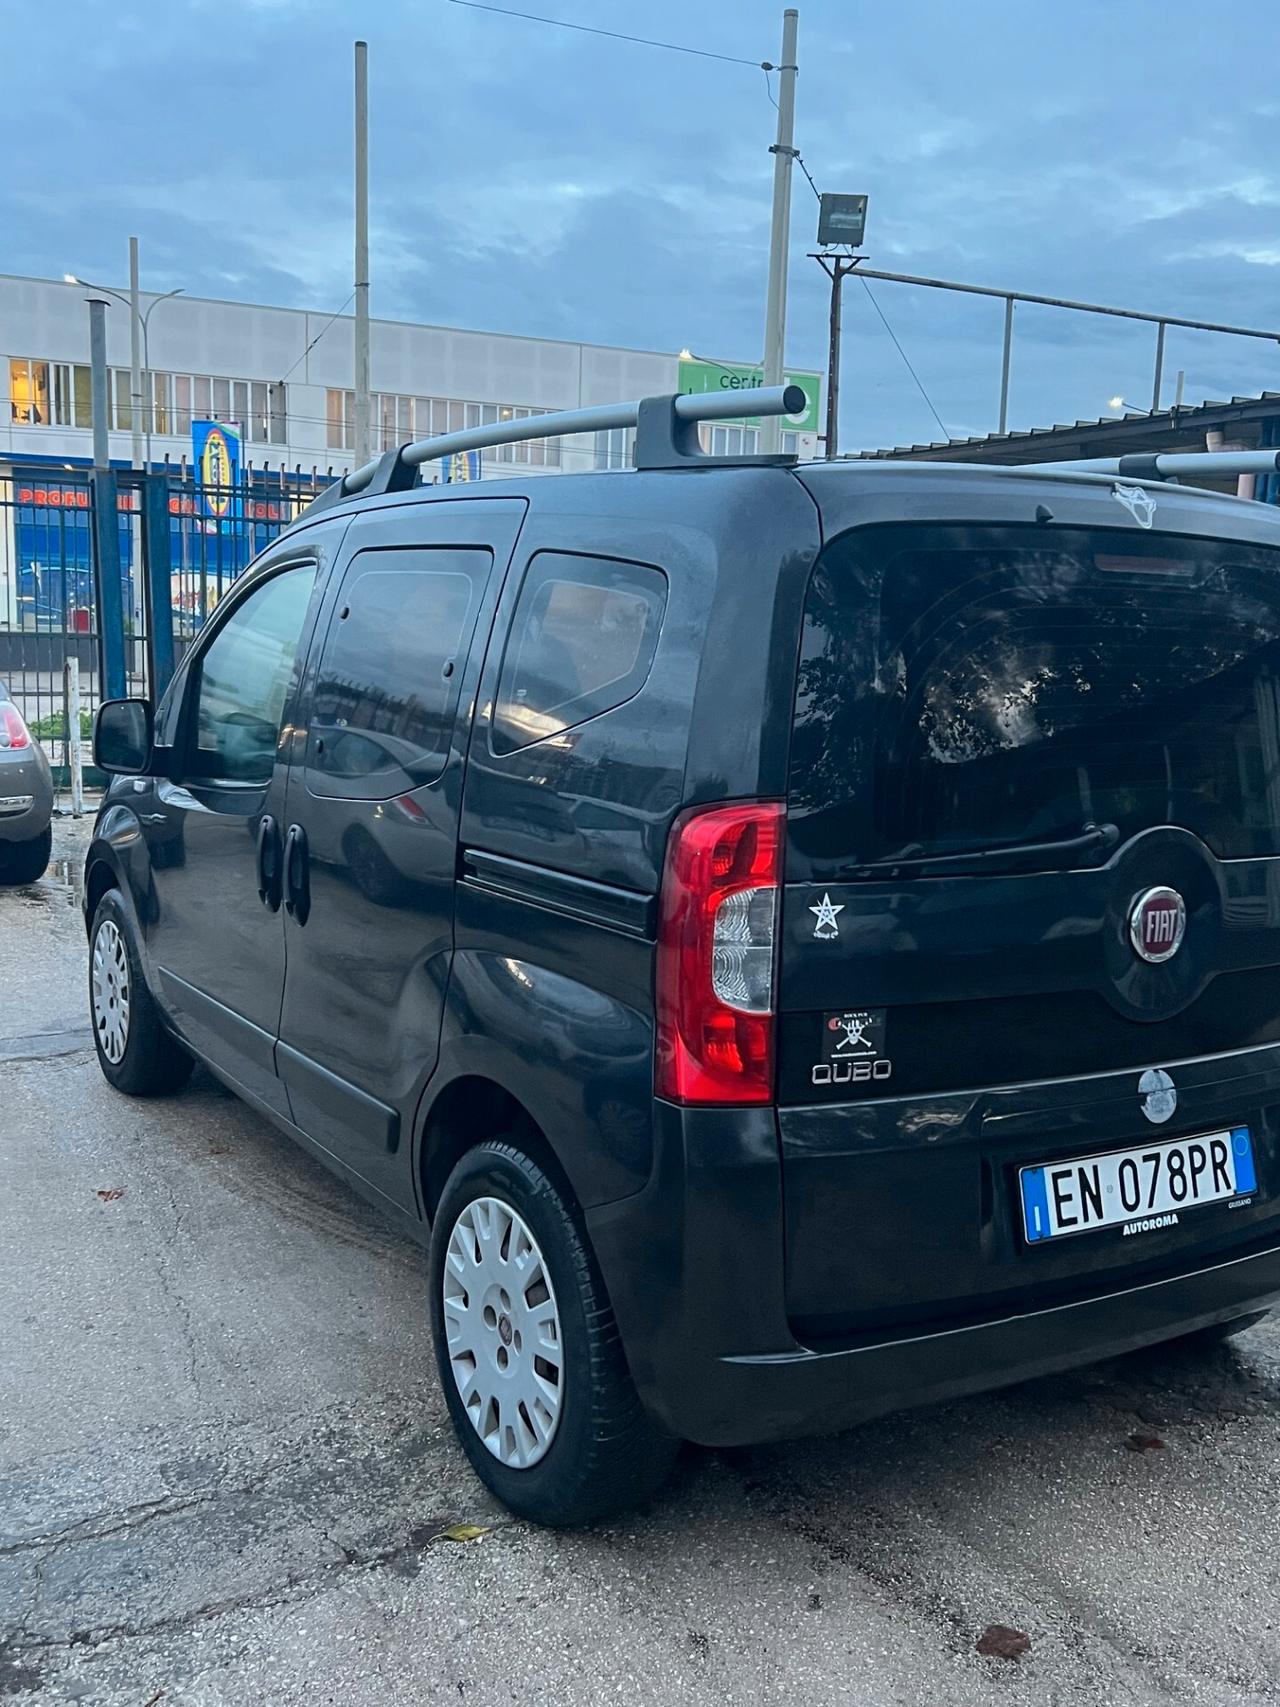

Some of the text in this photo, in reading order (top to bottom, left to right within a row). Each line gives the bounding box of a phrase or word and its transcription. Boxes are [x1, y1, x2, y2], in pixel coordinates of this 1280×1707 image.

[1146, 909, 1177, 943] FIAT
[812, 1060, 892, 1084] QUBO
[1051, 1164, 1104, 1228] EN
[1118, 1139, 1232, 1213] 078PR
[1122, 1213, 1179, 1236] AUTOROMA
